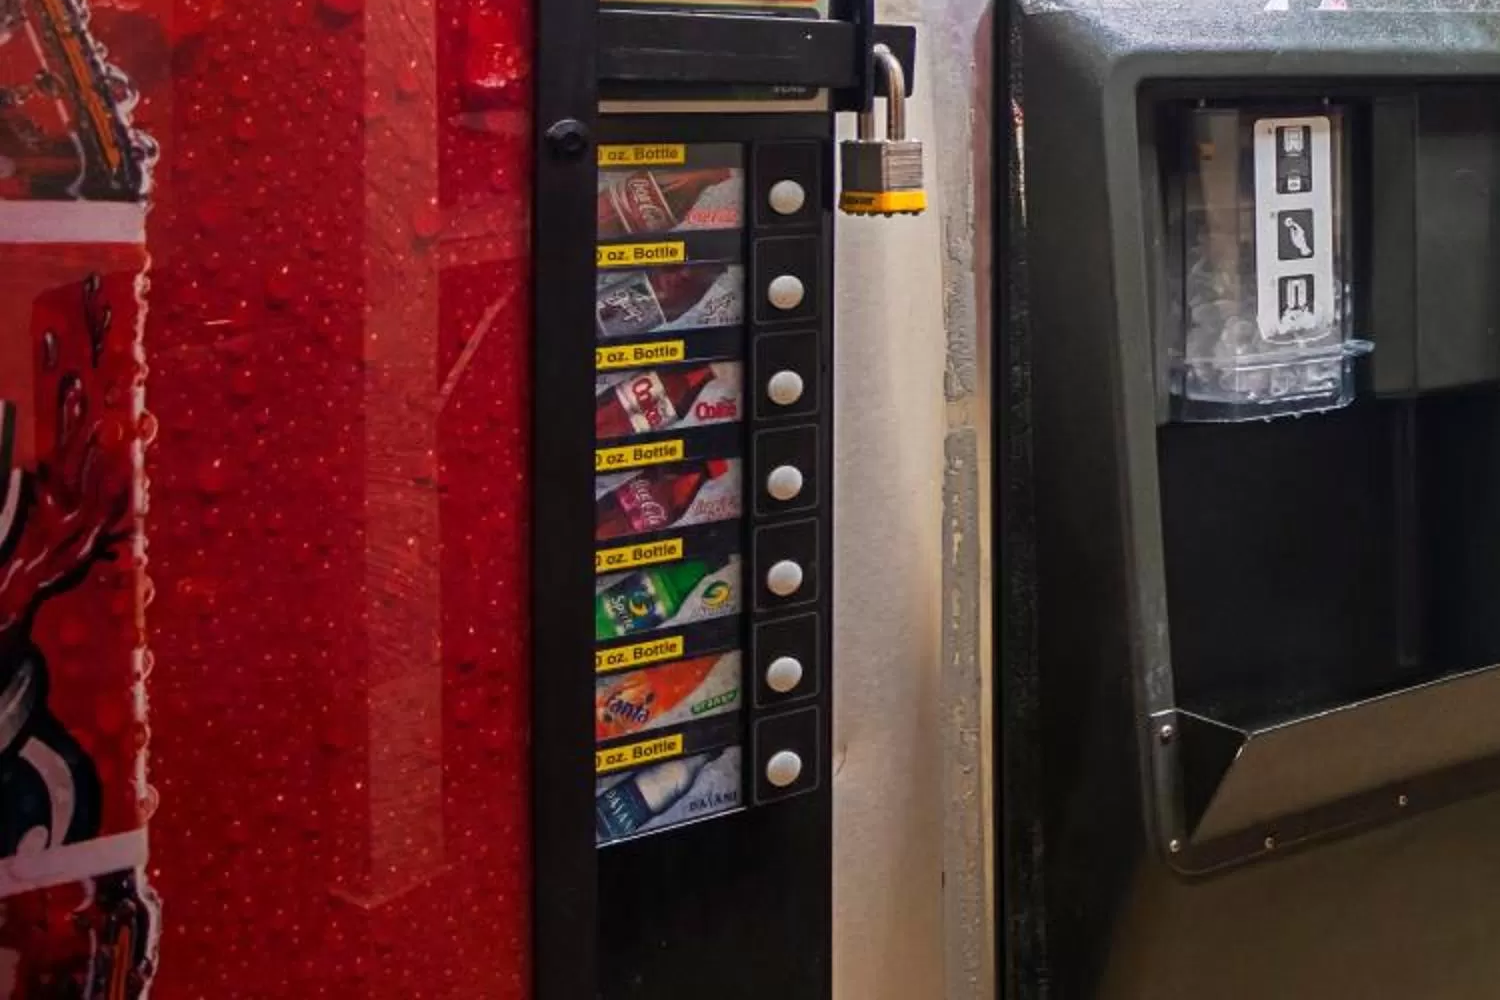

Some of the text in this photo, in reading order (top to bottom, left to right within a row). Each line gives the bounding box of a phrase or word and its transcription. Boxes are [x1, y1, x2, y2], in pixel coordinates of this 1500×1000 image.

[634, 147, 678, 161] Bottle
[634, 246, 678, 260] Bottle
[634, 346, 678, 361] Bottle
[633, 445, 677, 461] Bottle
[632, 544, 677, 561] Bottle
[633, 642, 677, 660] Bottle
[632, 740, 677, 759] Bottle
